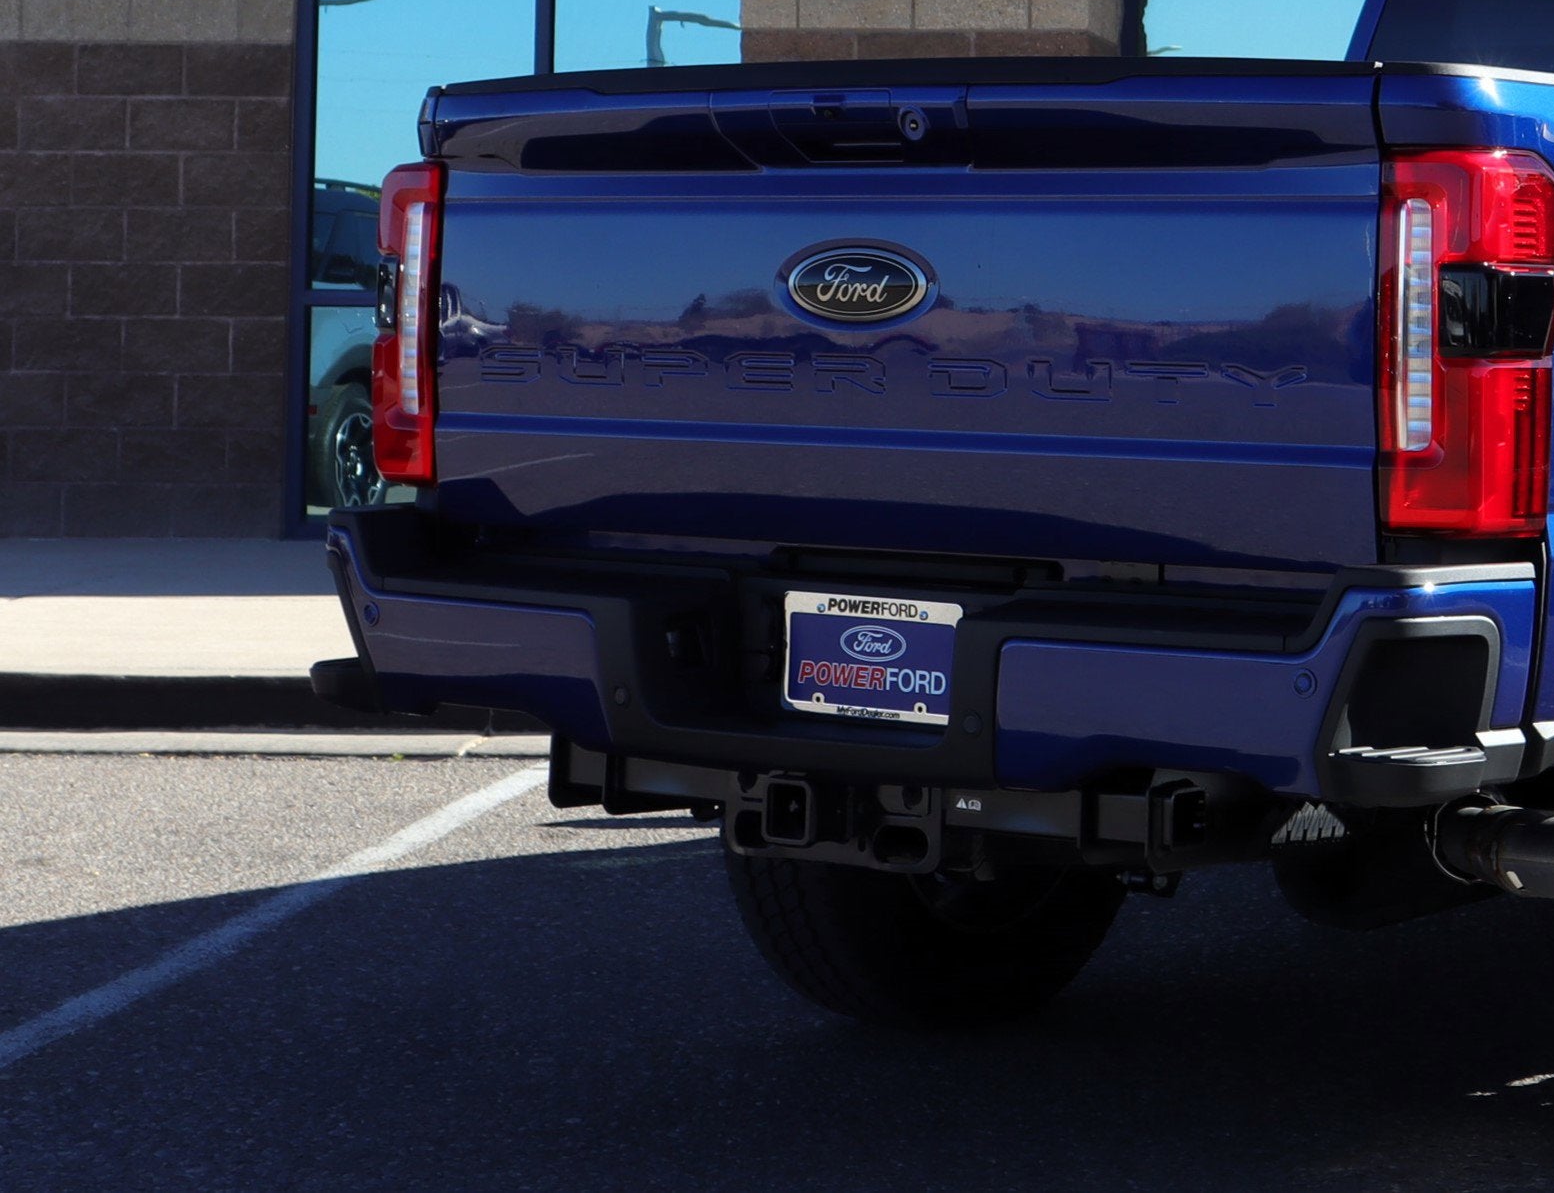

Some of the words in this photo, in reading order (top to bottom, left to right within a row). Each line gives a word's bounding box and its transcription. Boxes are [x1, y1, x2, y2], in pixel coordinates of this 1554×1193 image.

[816, 263, 890, 303] Ford
[480, 345, 887, 395] SUPER
[928, 357, 1308, 407] DUTY
[853, 630, 894, 655] Ford
